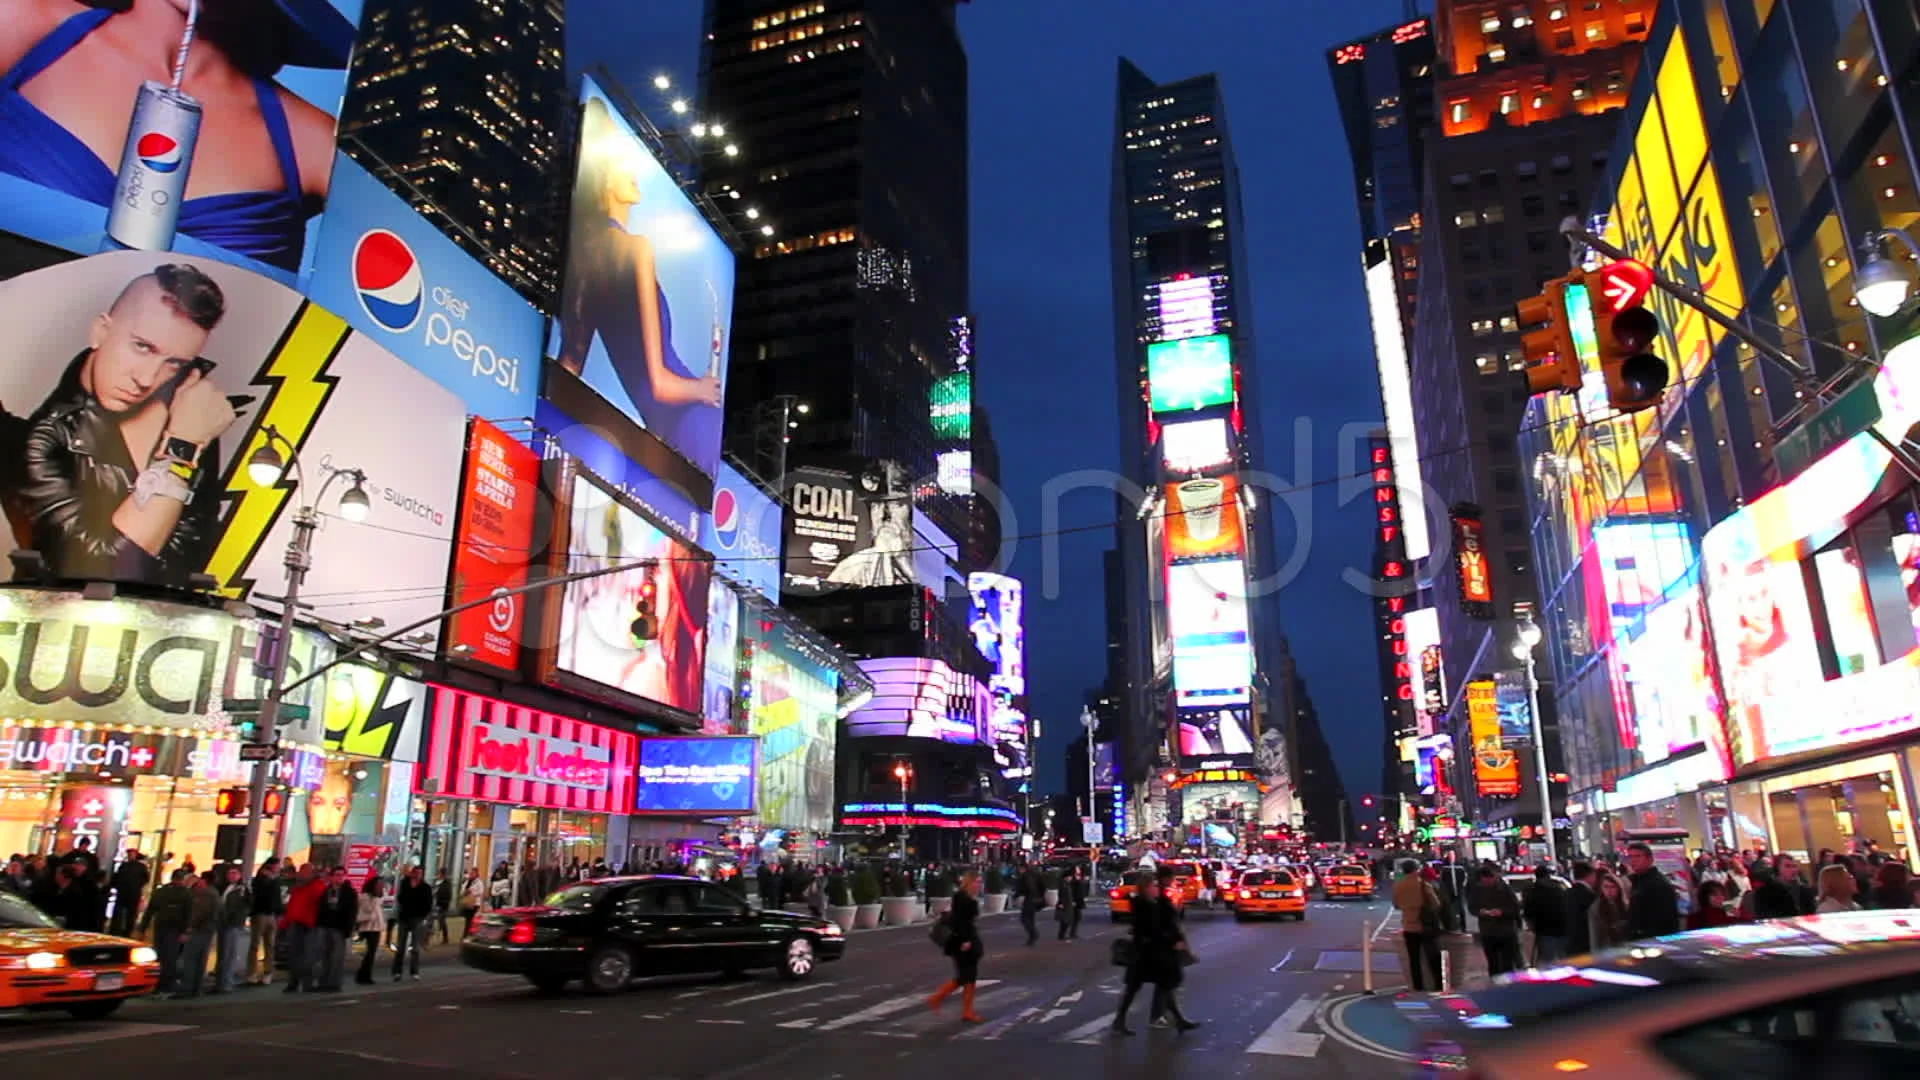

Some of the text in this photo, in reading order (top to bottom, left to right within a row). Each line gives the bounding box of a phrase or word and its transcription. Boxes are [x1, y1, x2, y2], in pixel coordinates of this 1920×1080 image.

[431, 286, 470, 321] diet
[424, 312, 518, 393] pepsi
[474, 482, 504, 507] APRIL
[476, 467, 517, 498] STARTS
[383, 487, 435, 521] swatch
[793, 482, 859, 522] COAL
[1373, 448, 1415, 700] ERNST & YOUNG
[472, 725, 610, 786] Foot Locker
